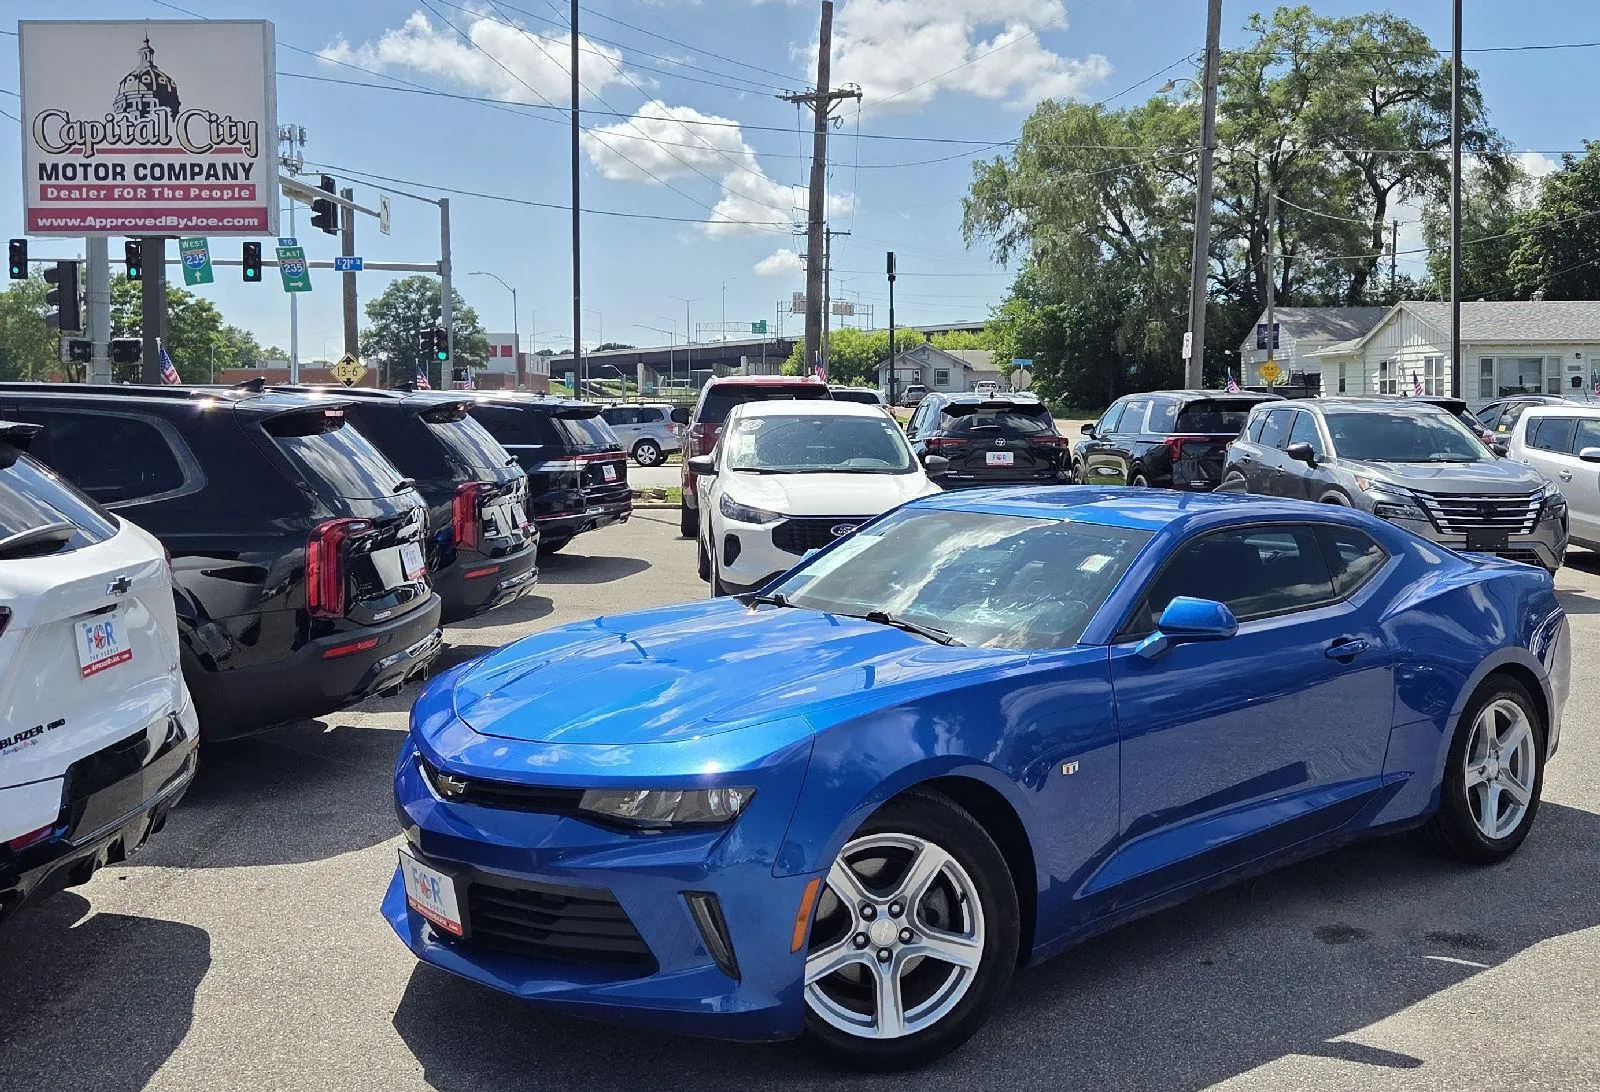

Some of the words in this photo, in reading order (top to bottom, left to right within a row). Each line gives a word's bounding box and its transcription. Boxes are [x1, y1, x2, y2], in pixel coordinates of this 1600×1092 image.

[33, 109, 172, 158] Capital
[176, 109, 259, 158] City
[39, 163, 126, 181] MOTOR
[134, 162, 255, 181] COMPANY
[47, 188, 107, 199] Dealer
[114, 188, 147, 199] FOR
[152, 188, 184, 199] The
[190, 187, 251, 200] People
[37, 216, 259, 229] www.ApprovedByJoe.com
[186, 253, 206, 265] 235
[279, 249, 301, 258] EAST
[283, 262, 304, 273] 235
[86, 621, 117, 654] FOR
